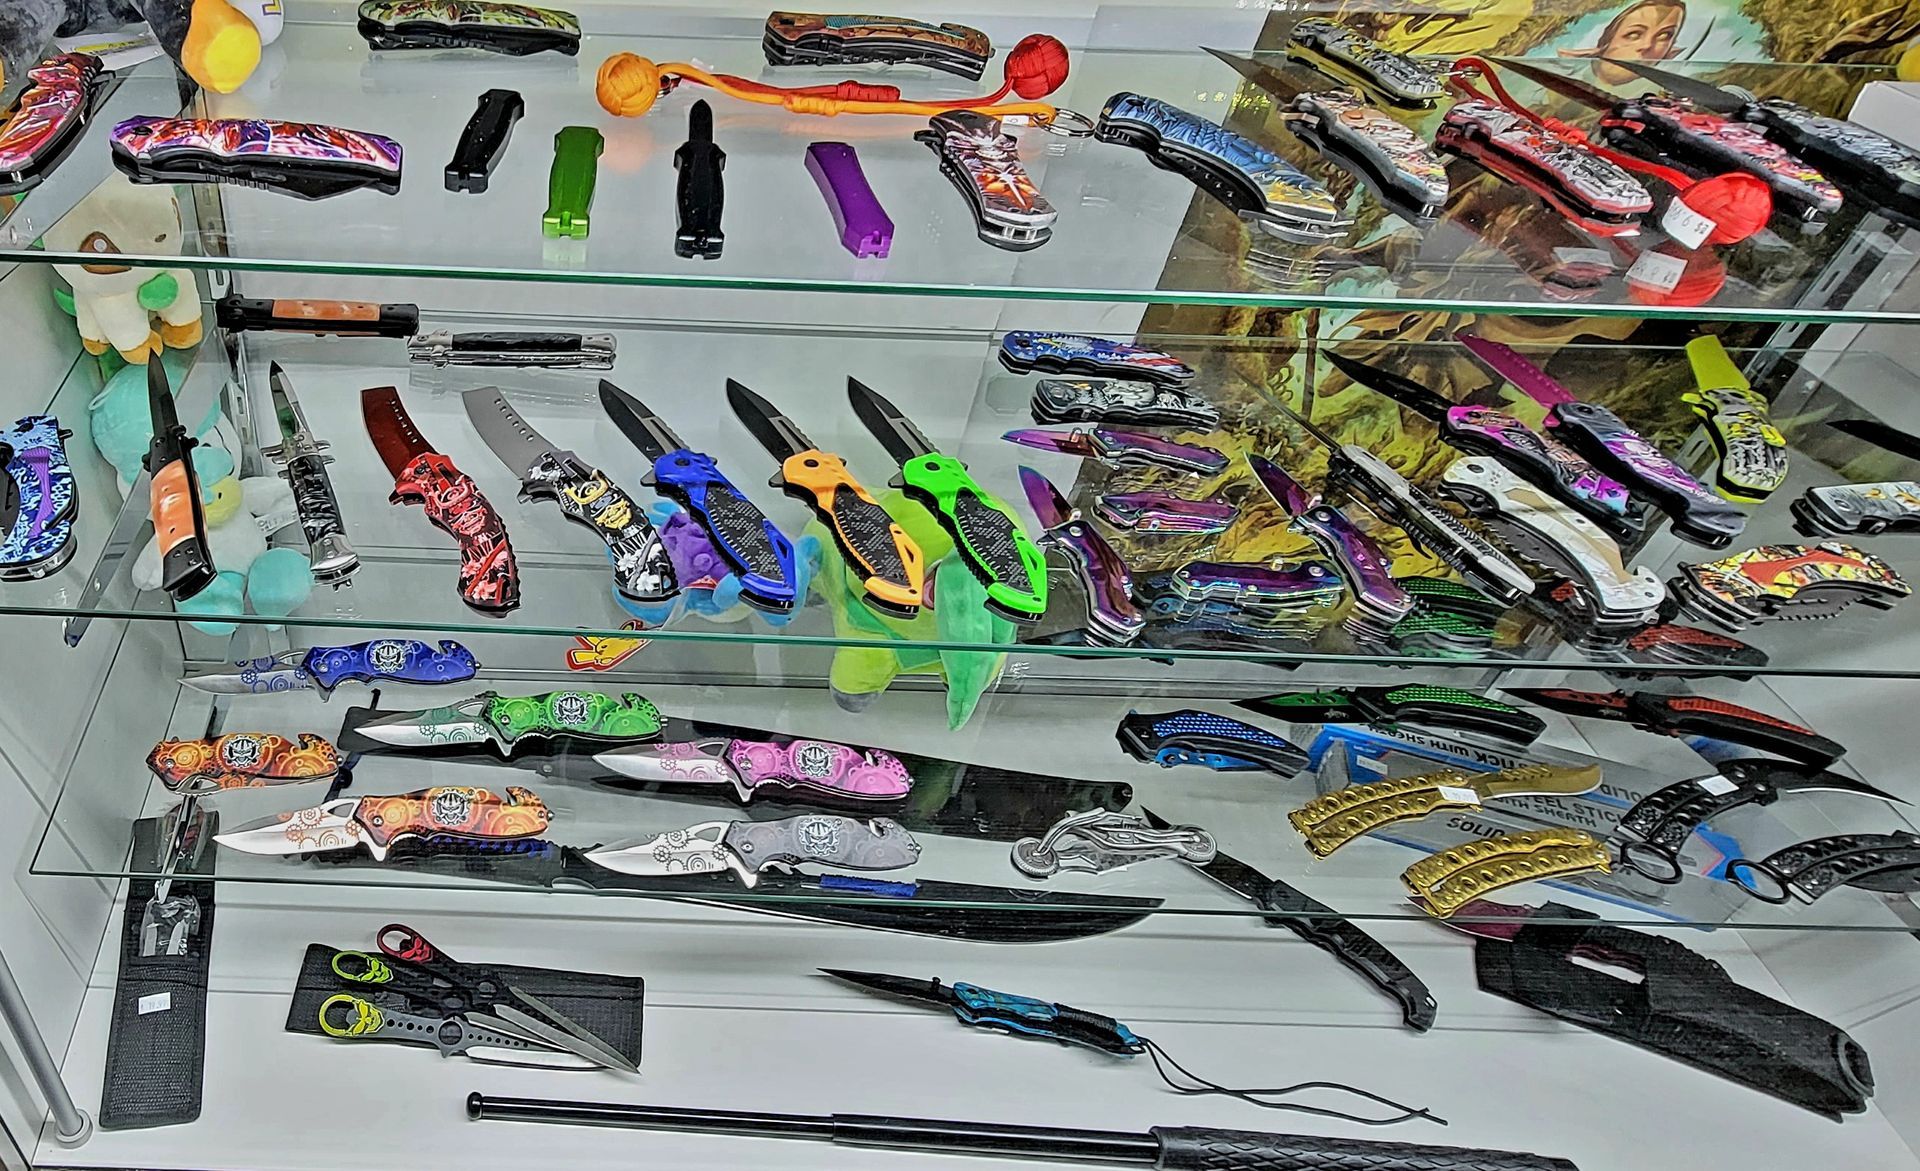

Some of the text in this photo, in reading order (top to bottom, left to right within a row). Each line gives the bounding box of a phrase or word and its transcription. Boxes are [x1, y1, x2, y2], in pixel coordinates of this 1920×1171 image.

[1430, 739, 1470, 757] WITH
[1599, 783, 1642, 802] OLID
[1533, 804, 1598, 828] SHEATH
